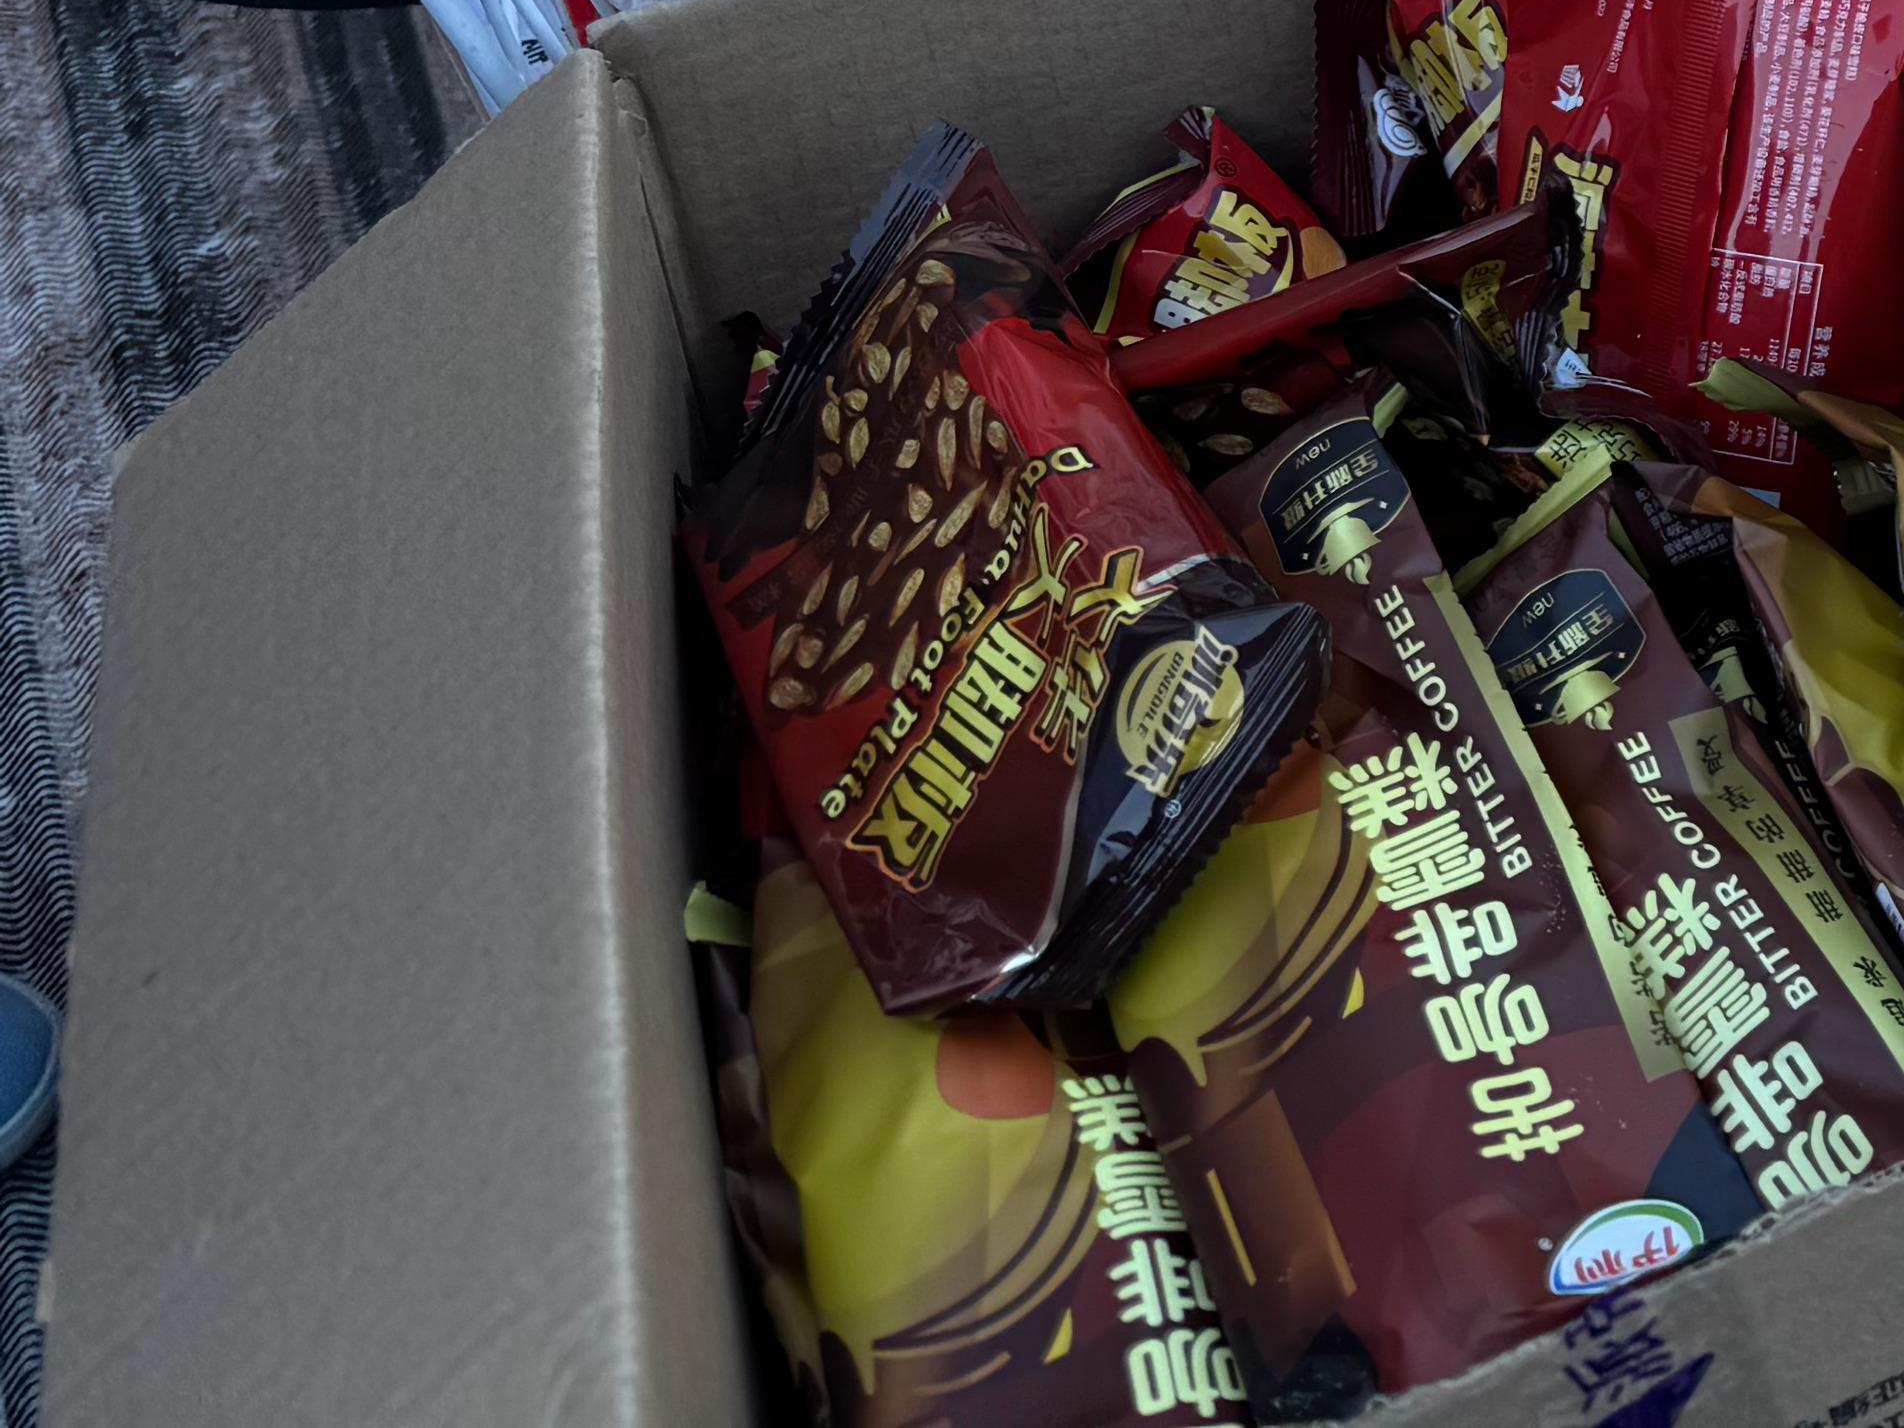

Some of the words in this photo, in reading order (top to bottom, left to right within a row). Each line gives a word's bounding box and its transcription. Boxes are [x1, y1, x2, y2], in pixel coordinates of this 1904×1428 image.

[1291, 439, 1331, 470] new
[1375, 582, 1461, 734] COFFEE
[1519, 589, 1556, 629] new
[818, 678, 923, 822] Plate
[1136, 650, 1186, 742] BINGDILE
[1453, 734, 1533, 879] BITTER
[1613, 729, 1726, 870] COFFEE
[1331, 730, 1586, 1162] 苦咖啡雪糕
[1709, 866, 1819, 1012] BITTER
